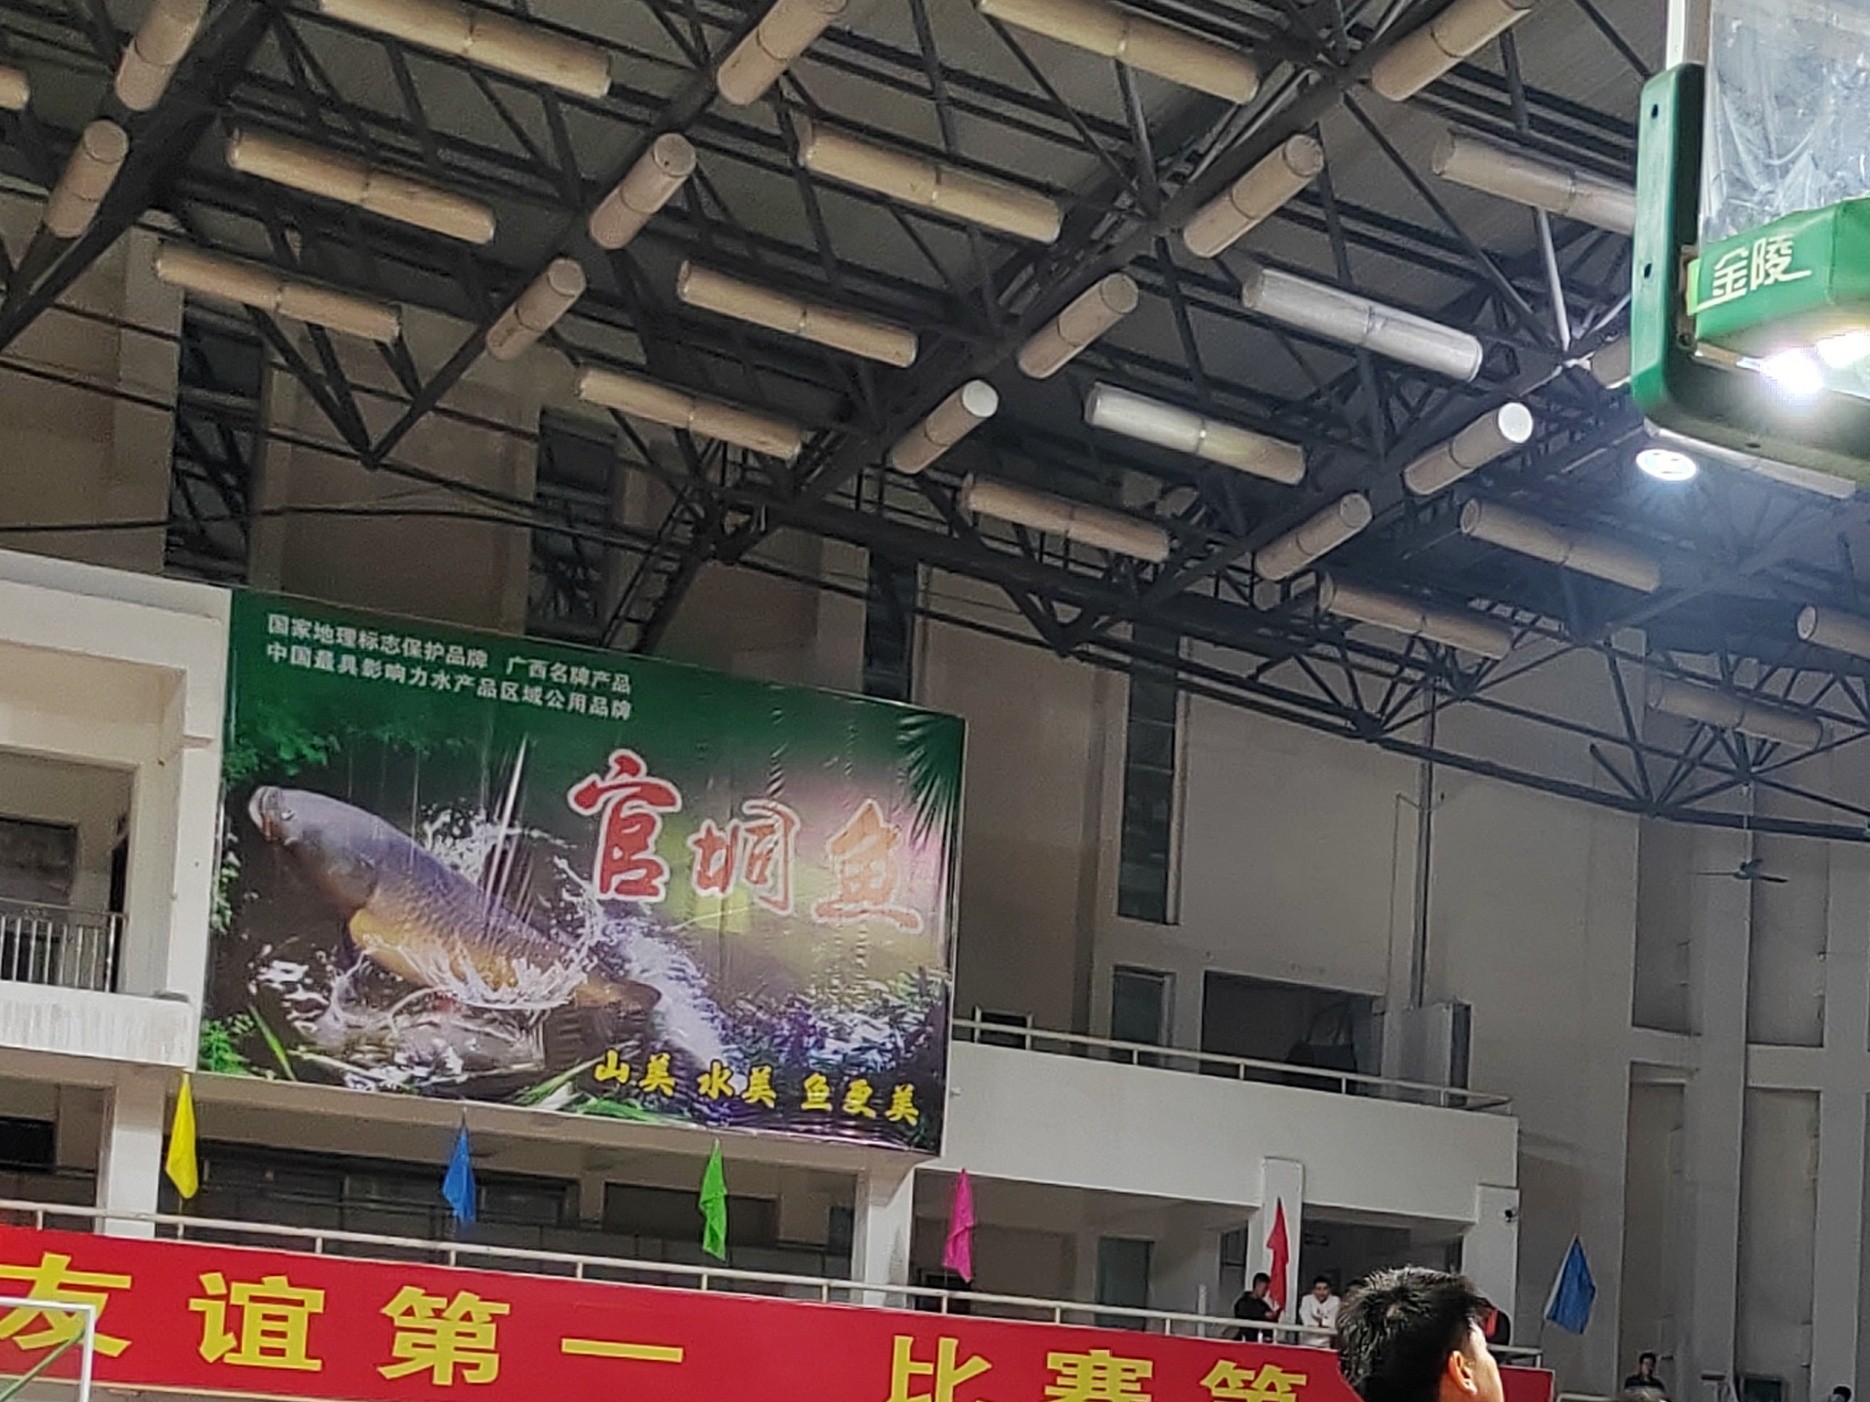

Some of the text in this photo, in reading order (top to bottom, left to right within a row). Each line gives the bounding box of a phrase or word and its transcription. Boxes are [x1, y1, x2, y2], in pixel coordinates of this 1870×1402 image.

[1697, 233, 1812, 312] 金陵
[266, 641, 633, 720] 中国最具影响力水产品区域公用品牌
[267, 613, 632, 695] 国家地理标志保护品牌 广西名牌产品
[0, 1251, 685, 1386] 友谊第一
